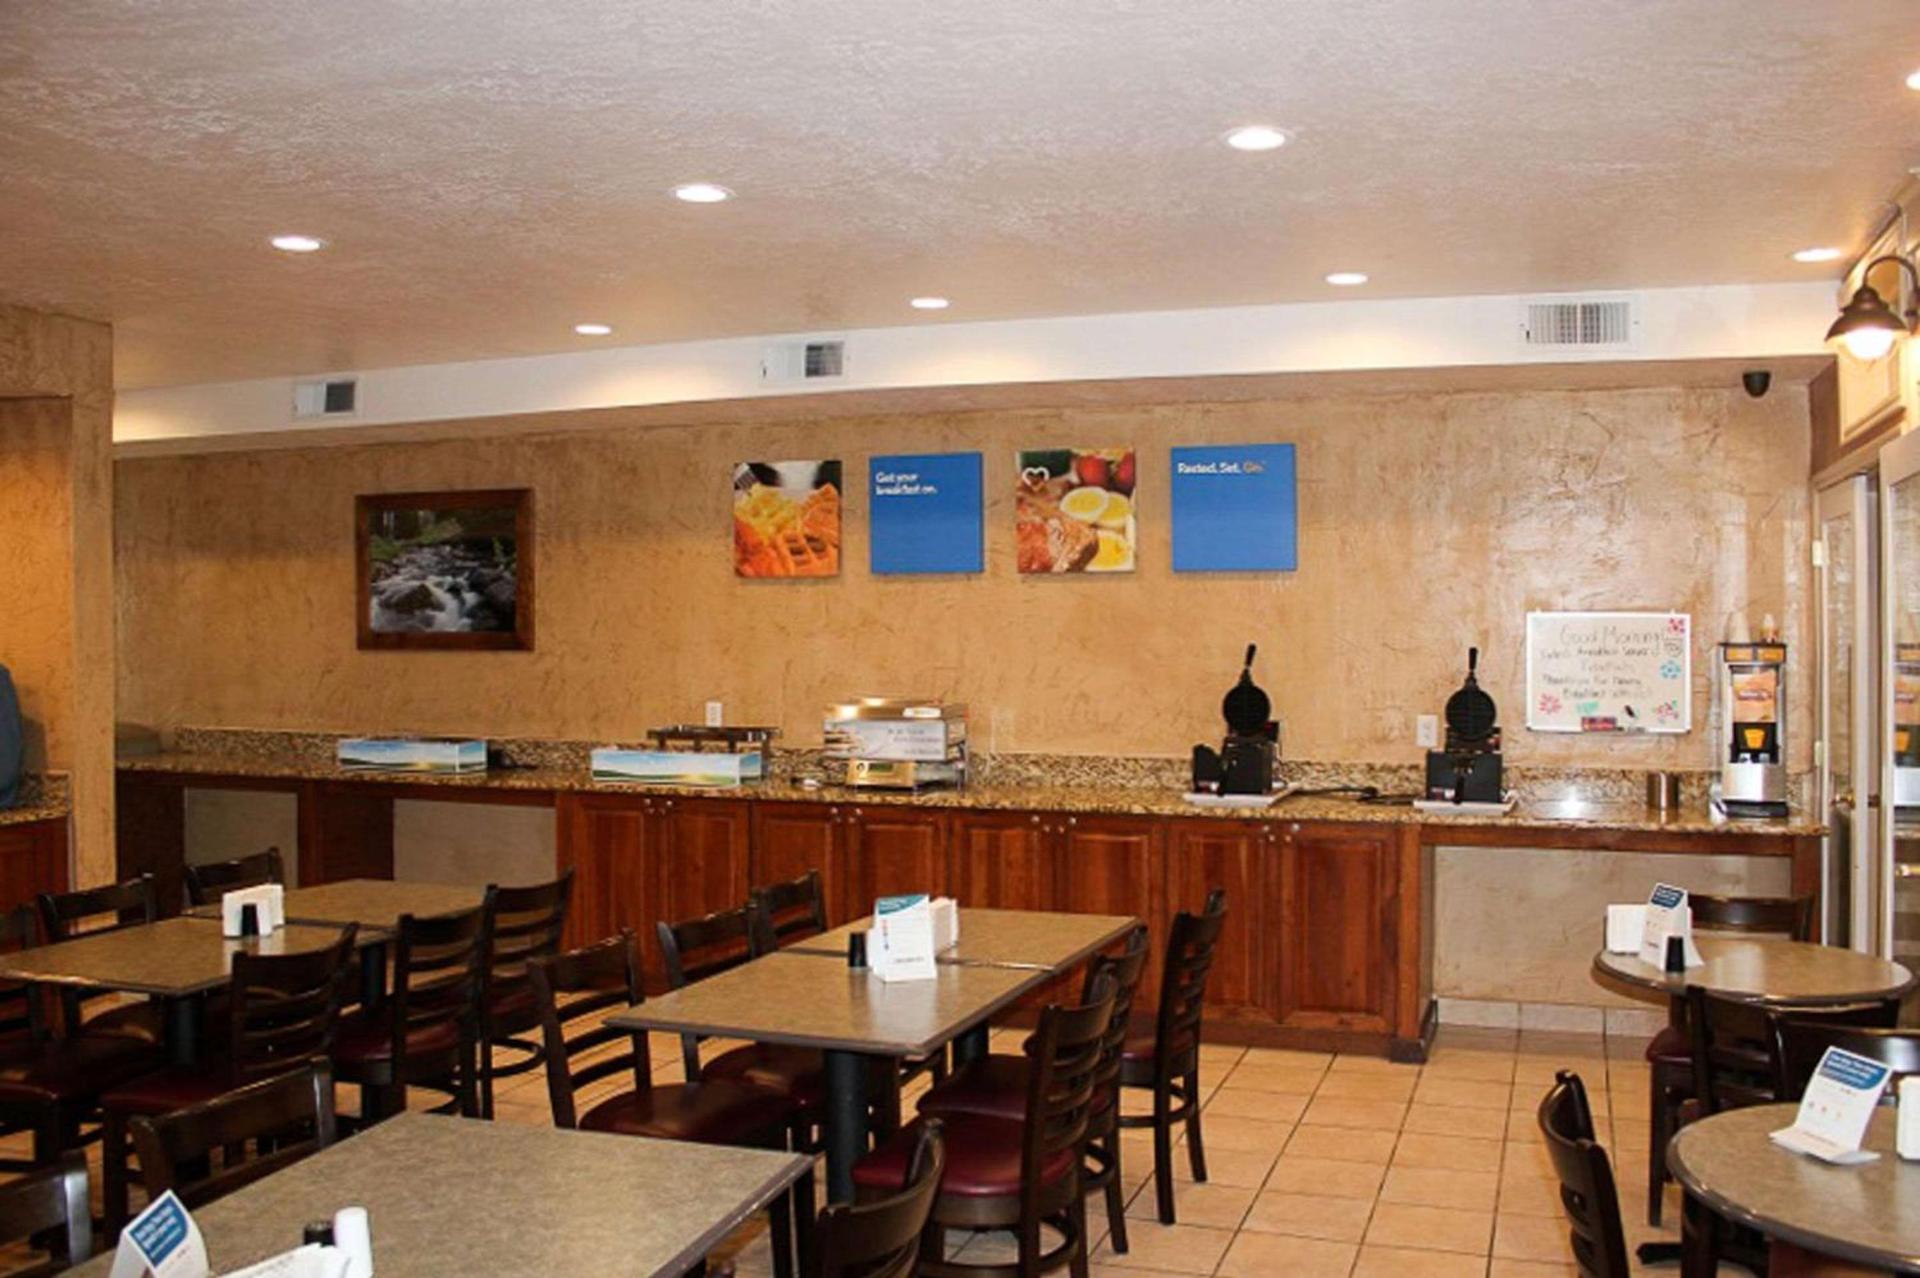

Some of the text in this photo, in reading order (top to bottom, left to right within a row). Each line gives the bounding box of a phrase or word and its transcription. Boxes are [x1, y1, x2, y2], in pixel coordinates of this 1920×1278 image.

[875, 471, 918, 487] Get your
[875, 484, 938, 496] breakfast on.
